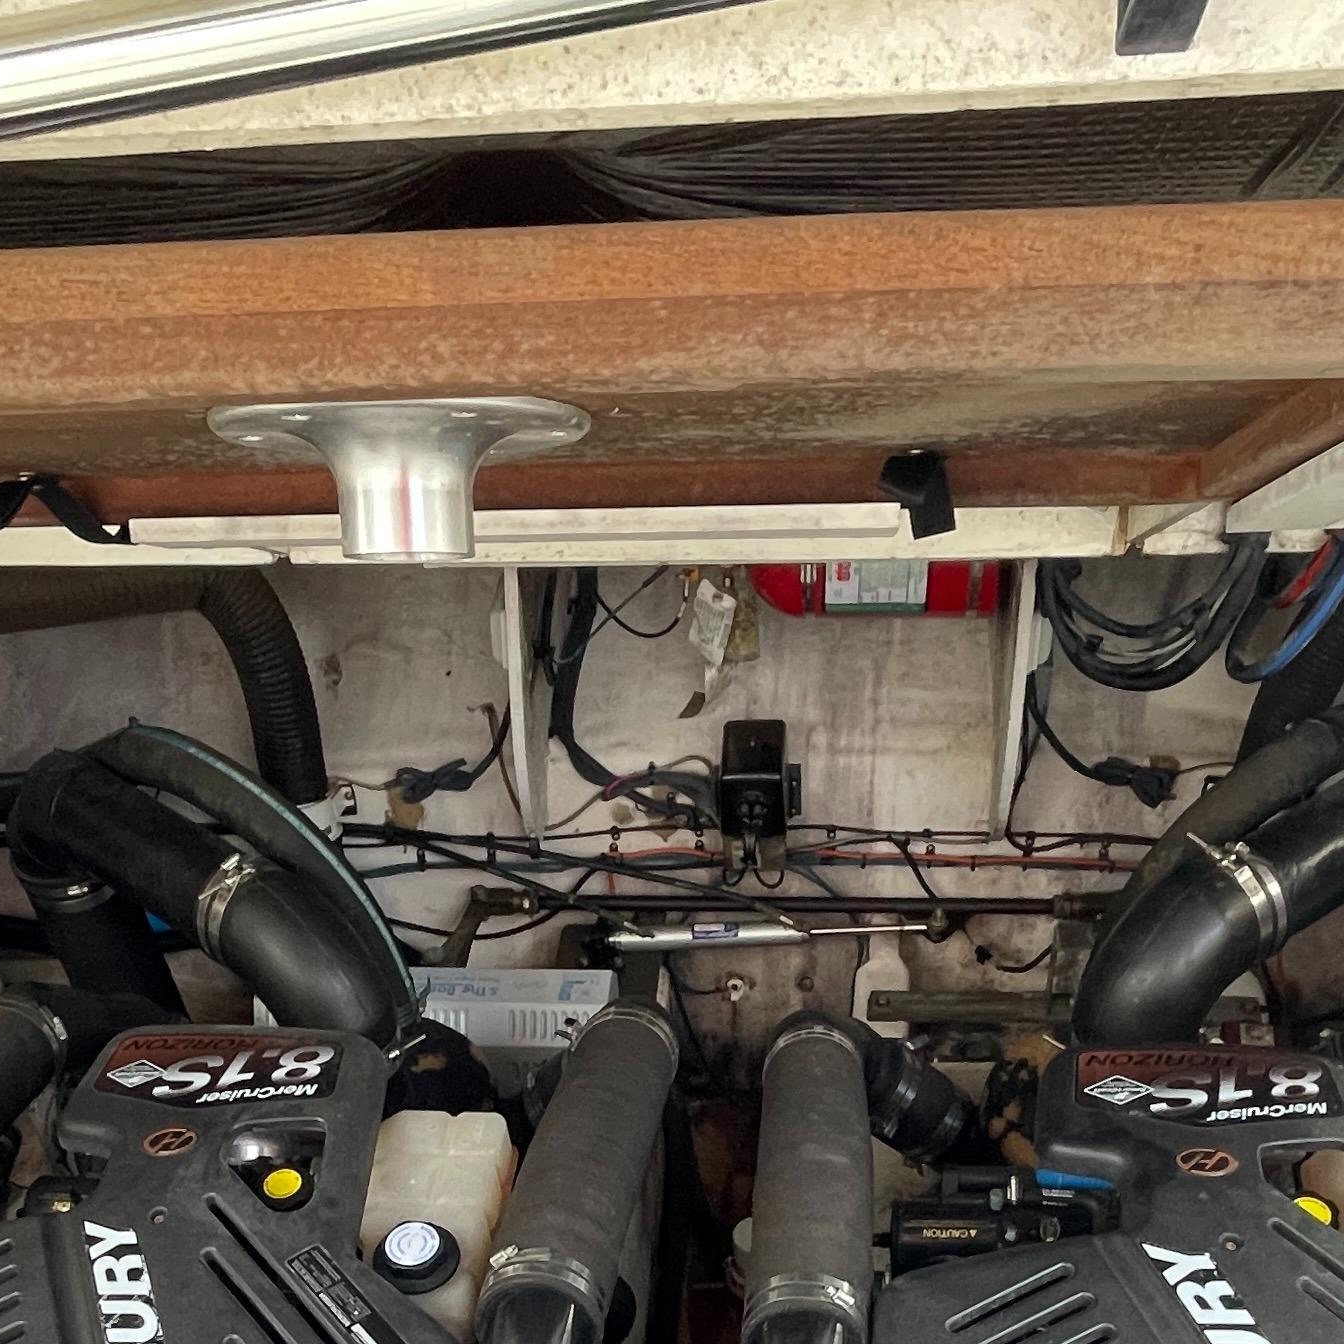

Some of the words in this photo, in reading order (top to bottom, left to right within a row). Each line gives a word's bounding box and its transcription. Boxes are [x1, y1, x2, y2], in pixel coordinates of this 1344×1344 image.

[126, 1038, 256, 1050] HORIZON
[1086, 1053, 1234, 1067] HORIZON
[152, 1045, 335, 1097] 8.1S
[195, 1083, 318, 1104] MerCruiser
[1150, 1062, 1323, 1117] 8.1S
[1206, 1102, 1327, 1122] MerCruiser
[922, 1228, 968, 1239] CAUTION
